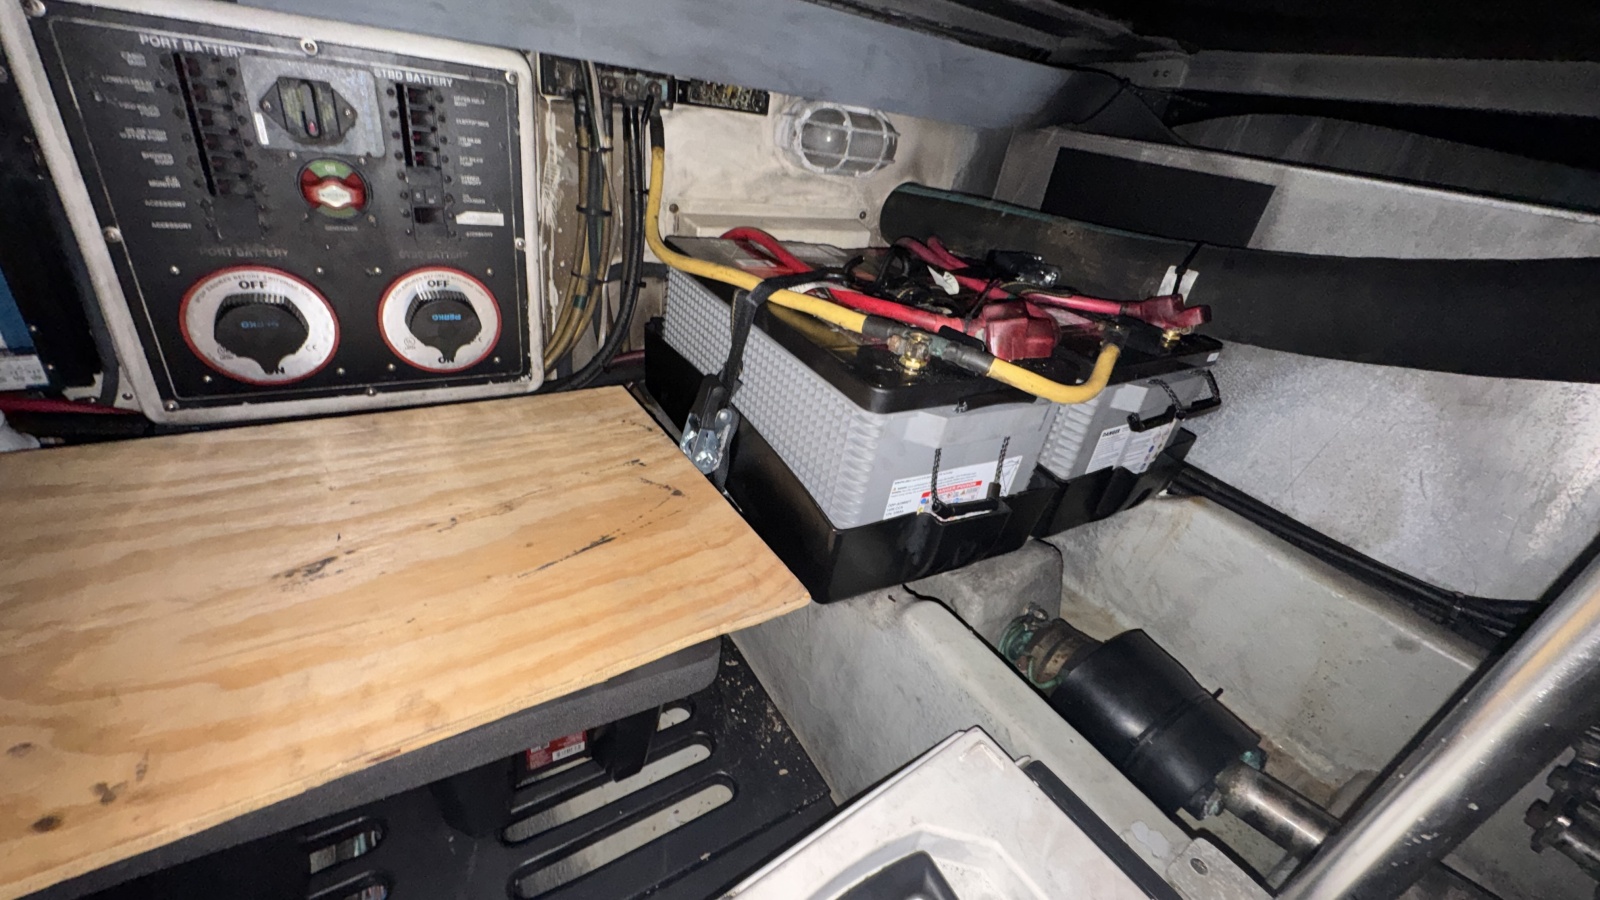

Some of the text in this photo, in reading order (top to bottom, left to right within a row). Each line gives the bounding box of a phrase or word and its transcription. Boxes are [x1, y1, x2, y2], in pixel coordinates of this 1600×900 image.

[139, 33, 246, 57] PORT BATTERY
[373, 67, 453, 88] STBD BATTERY
[238, 280, 268, 290] OFF
[427, 280, 450, 288] OFF
